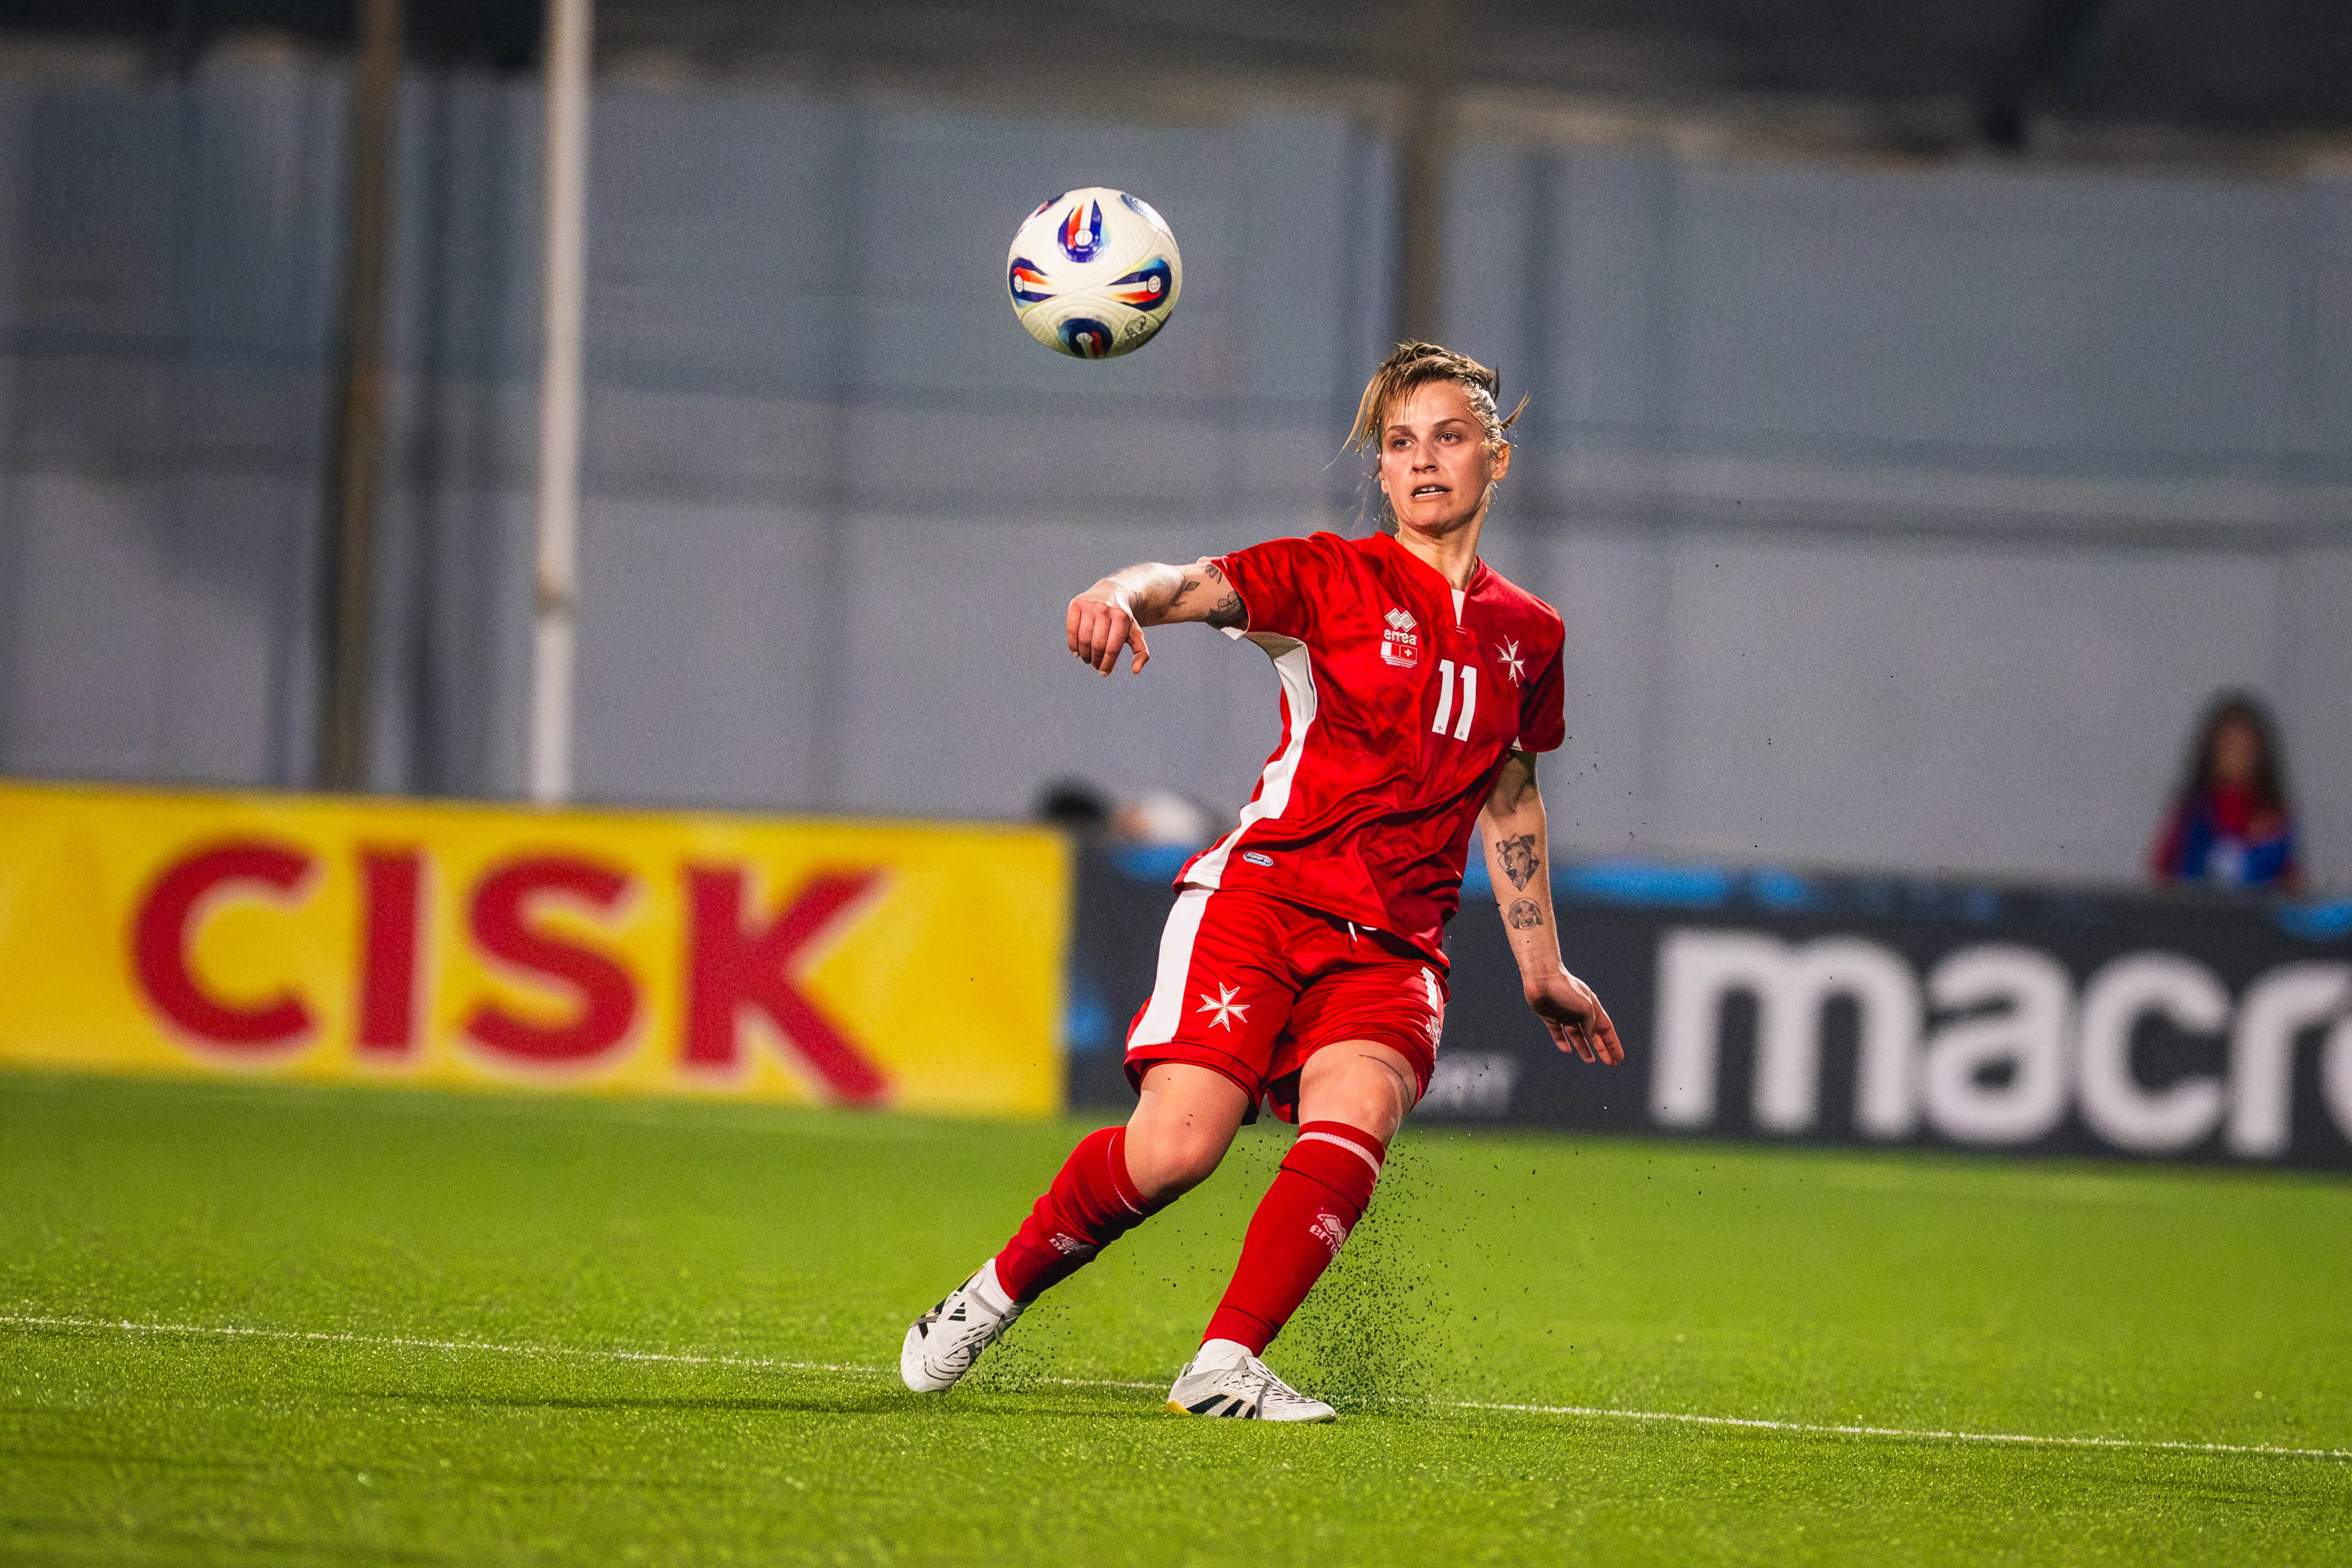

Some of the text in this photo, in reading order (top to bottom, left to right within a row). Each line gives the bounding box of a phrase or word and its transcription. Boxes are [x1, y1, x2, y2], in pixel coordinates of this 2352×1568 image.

[1432, 659, 1477, 742] 11
[126, 832, 896, 1110] CISK
[1652, 927, 2352, 1156] macr
